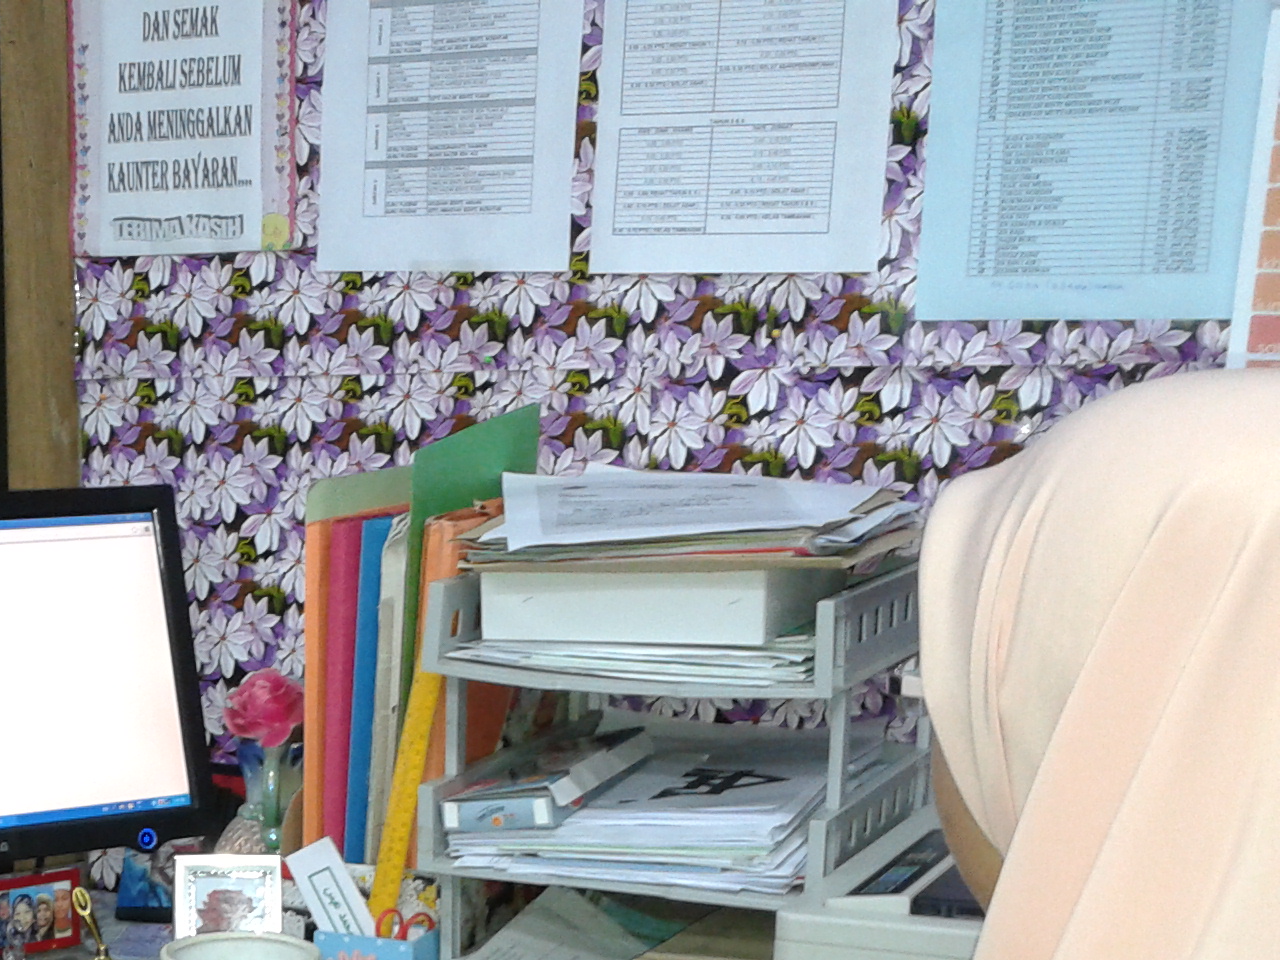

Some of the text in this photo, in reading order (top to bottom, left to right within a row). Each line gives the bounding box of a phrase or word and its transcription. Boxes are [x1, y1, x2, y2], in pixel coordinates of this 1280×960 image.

[142, 5, 219, 42] DAN SEMAK
[118, 54, 241, 94] KEMBALI SEBELUM
[107, 104, 252, 144] ANDA MENINGGALKAN
[107, 159, 169, 193] KAUNTER
[111, 213, 244, 242] TERIMA KASIH
